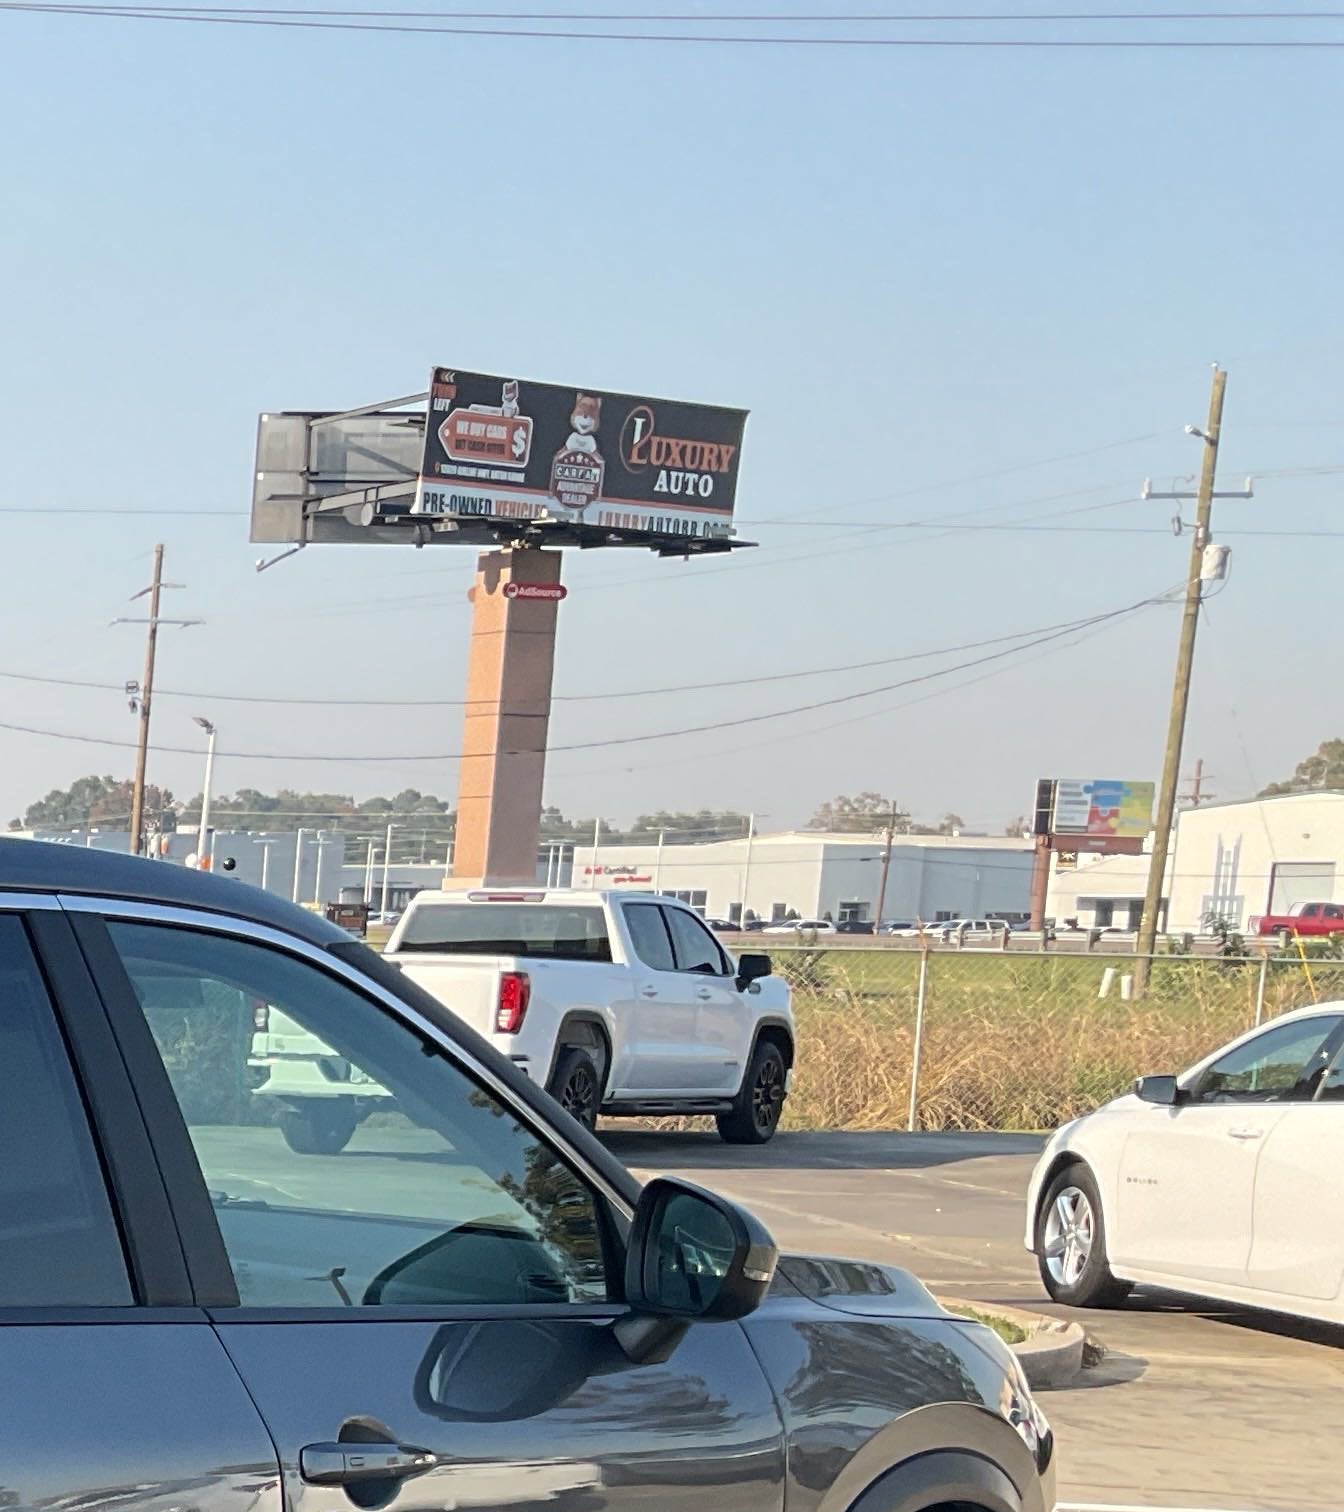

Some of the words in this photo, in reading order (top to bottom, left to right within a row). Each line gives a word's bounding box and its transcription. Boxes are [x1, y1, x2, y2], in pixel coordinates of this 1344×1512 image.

[626, 415, 736, 473] LUXURY
[556, 466, 600, 482] CARFAX
[653, 470, 714, 497] AUTO
[423, 492, 492, 514] PRE-OWNED
